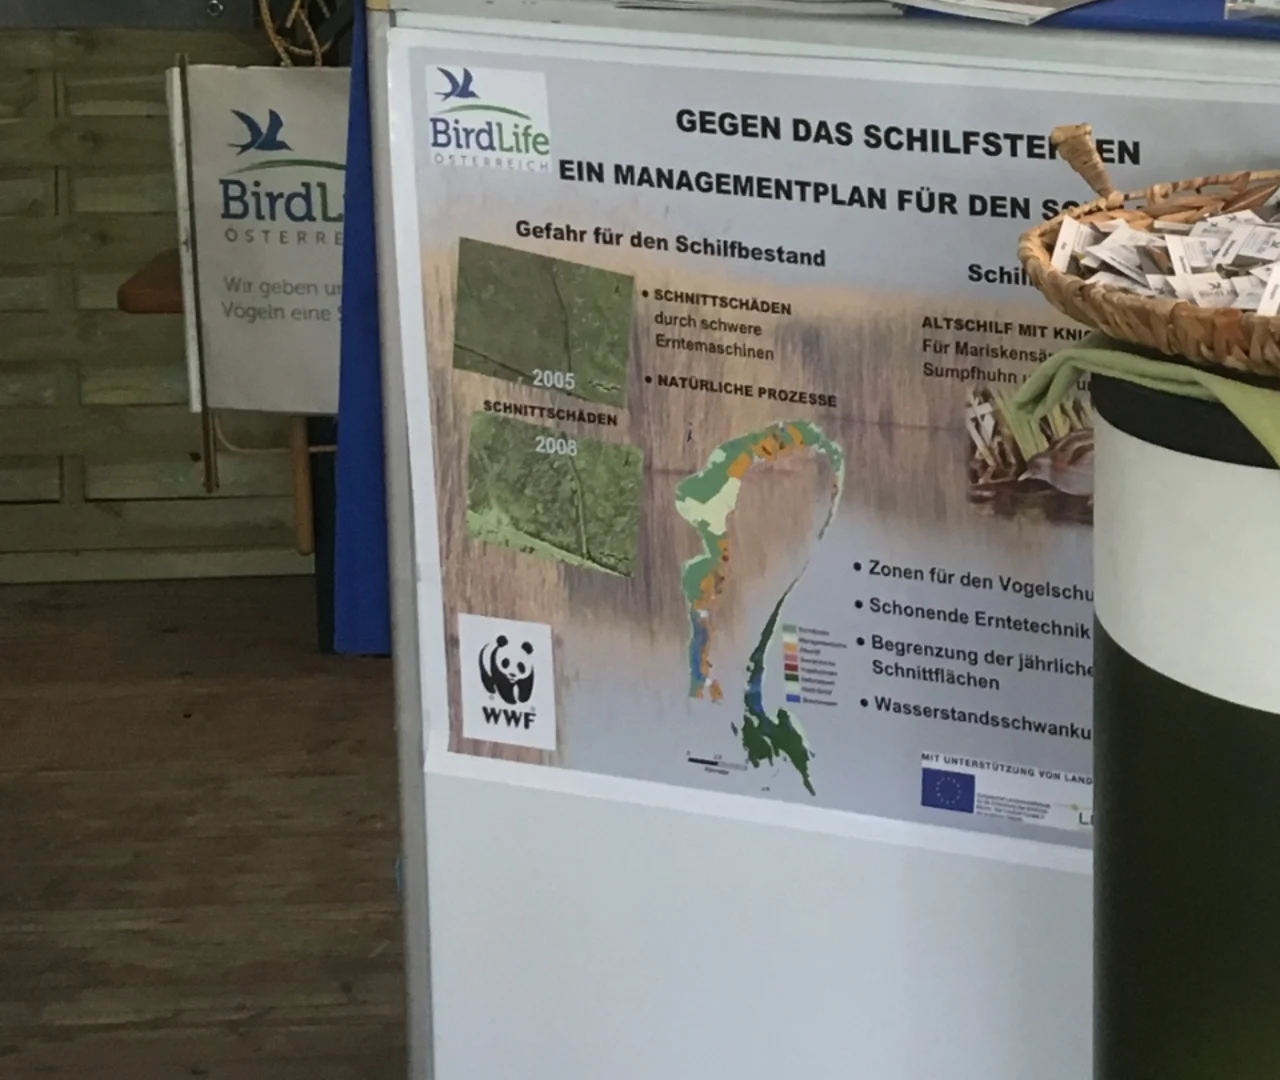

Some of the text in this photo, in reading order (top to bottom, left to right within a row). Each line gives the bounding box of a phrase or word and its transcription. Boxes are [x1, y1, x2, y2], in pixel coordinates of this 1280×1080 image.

[429, 117, 550, 156] BirdLife
[676, 108, 1140, 165] GEGEN DAS SCHILFSTEEN
[434, 152, 548, 171] ÖSTERREICH
[219, 178, 344, 223] BirdL
[559, 159, 604, 183] EIN
[614, 164, 886, 210] MANAGEMENTPLAN
[898, 186, 958, 215] FÜR
[969, 194, 1030, 220] DEN
[516, 220, 827, 267] Gefahr für den Schilfbestand
[224, 276, 254, 293] Wir
[259, 279, 318, 298] geben
[654, 287, 792, 315] SCHNITTSCHÄDEN
[291, 305, 331, 321] eine
[654, 310, 762, 336] durch schwere
[922, 315, 1014, 335] ALTSCHILF
[1018, 323, 1048, 338] MIT
[656, 333, 774, 361] Erntemaschinen
[922, 338, 950, 354] Für
[532, 368, 576, 390] 2005
[923, 363, 1017, 384] Sumpfhuhn
[658, 373, 838, 408] NATÜRLICHE PROZESSE
[483, 399, 618, 427] SCHNITTSCHÄDEN
[535, 436, 578, 456] 2008
[869, 560, 924, 581] Zonen
[930, 567, 955, 585] für
[960, 572, 993, 590] den
[869, 597, 1091, 640] Schonende Erntetechnik
[871, 634, 979, 666] Begrenzung
[984, 649, 1014, 666] der
[872, 660, 1000, 691] Schnittflächen
[482, 705, 536, 730] WWF
[921, 752, 940, 763] MIT
[944, 755, 1035, 778] UNTERSTÜTZUNG
[1039, 770, 1060, 780] VON
